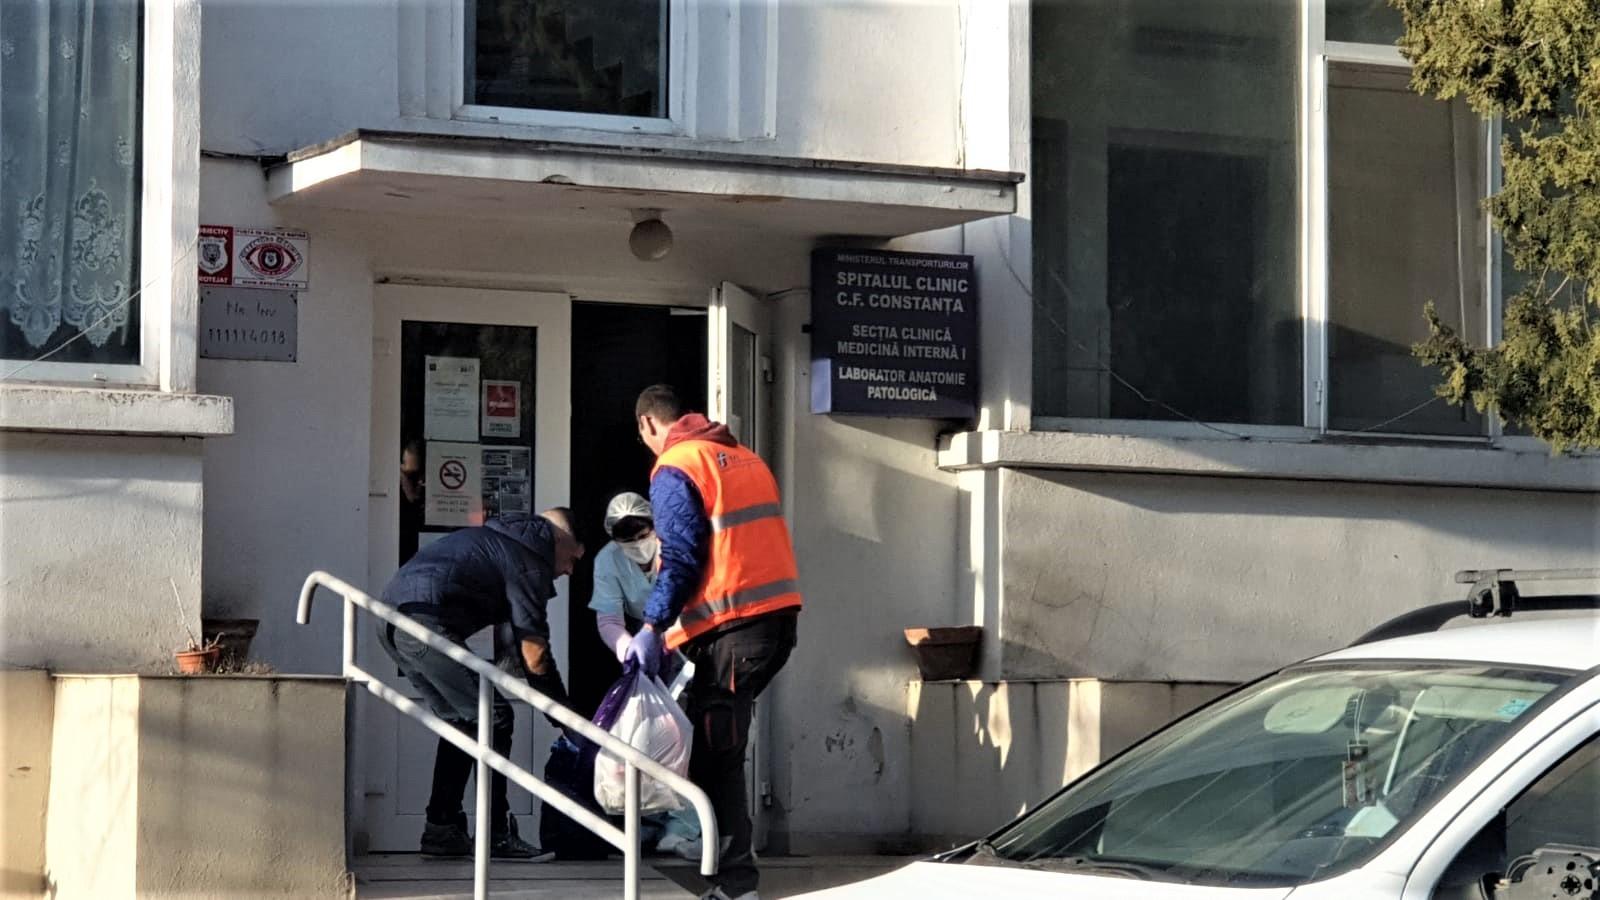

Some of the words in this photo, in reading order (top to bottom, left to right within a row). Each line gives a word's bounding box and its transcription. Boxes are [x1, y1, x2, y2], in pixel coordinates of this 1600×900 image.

[837, 253, 887, 265] MINISTERUL
[888, 257, 969, 269] TRANSPORTURILOR
[837, 271, 912, 290] SPITALUL
[915, 277, 969, 293] CLINIC
[837, 292, 865, 307] C.F.
[869, 293, 965, 316] CONSTANȚA
[853, 324, 898, 341] SECȚIA
[901, 327, 952, 342] CLINICĂ
[838, 341, 900, 357] MEDICINĂ
[903, 344, 959, 360] INTERNĂ
[838, 366, 906, 382] LABORATOR
[908, 370, 966, 385] ANATOMIE
[867, 386, 937, 401] PATOLOGICĂ
